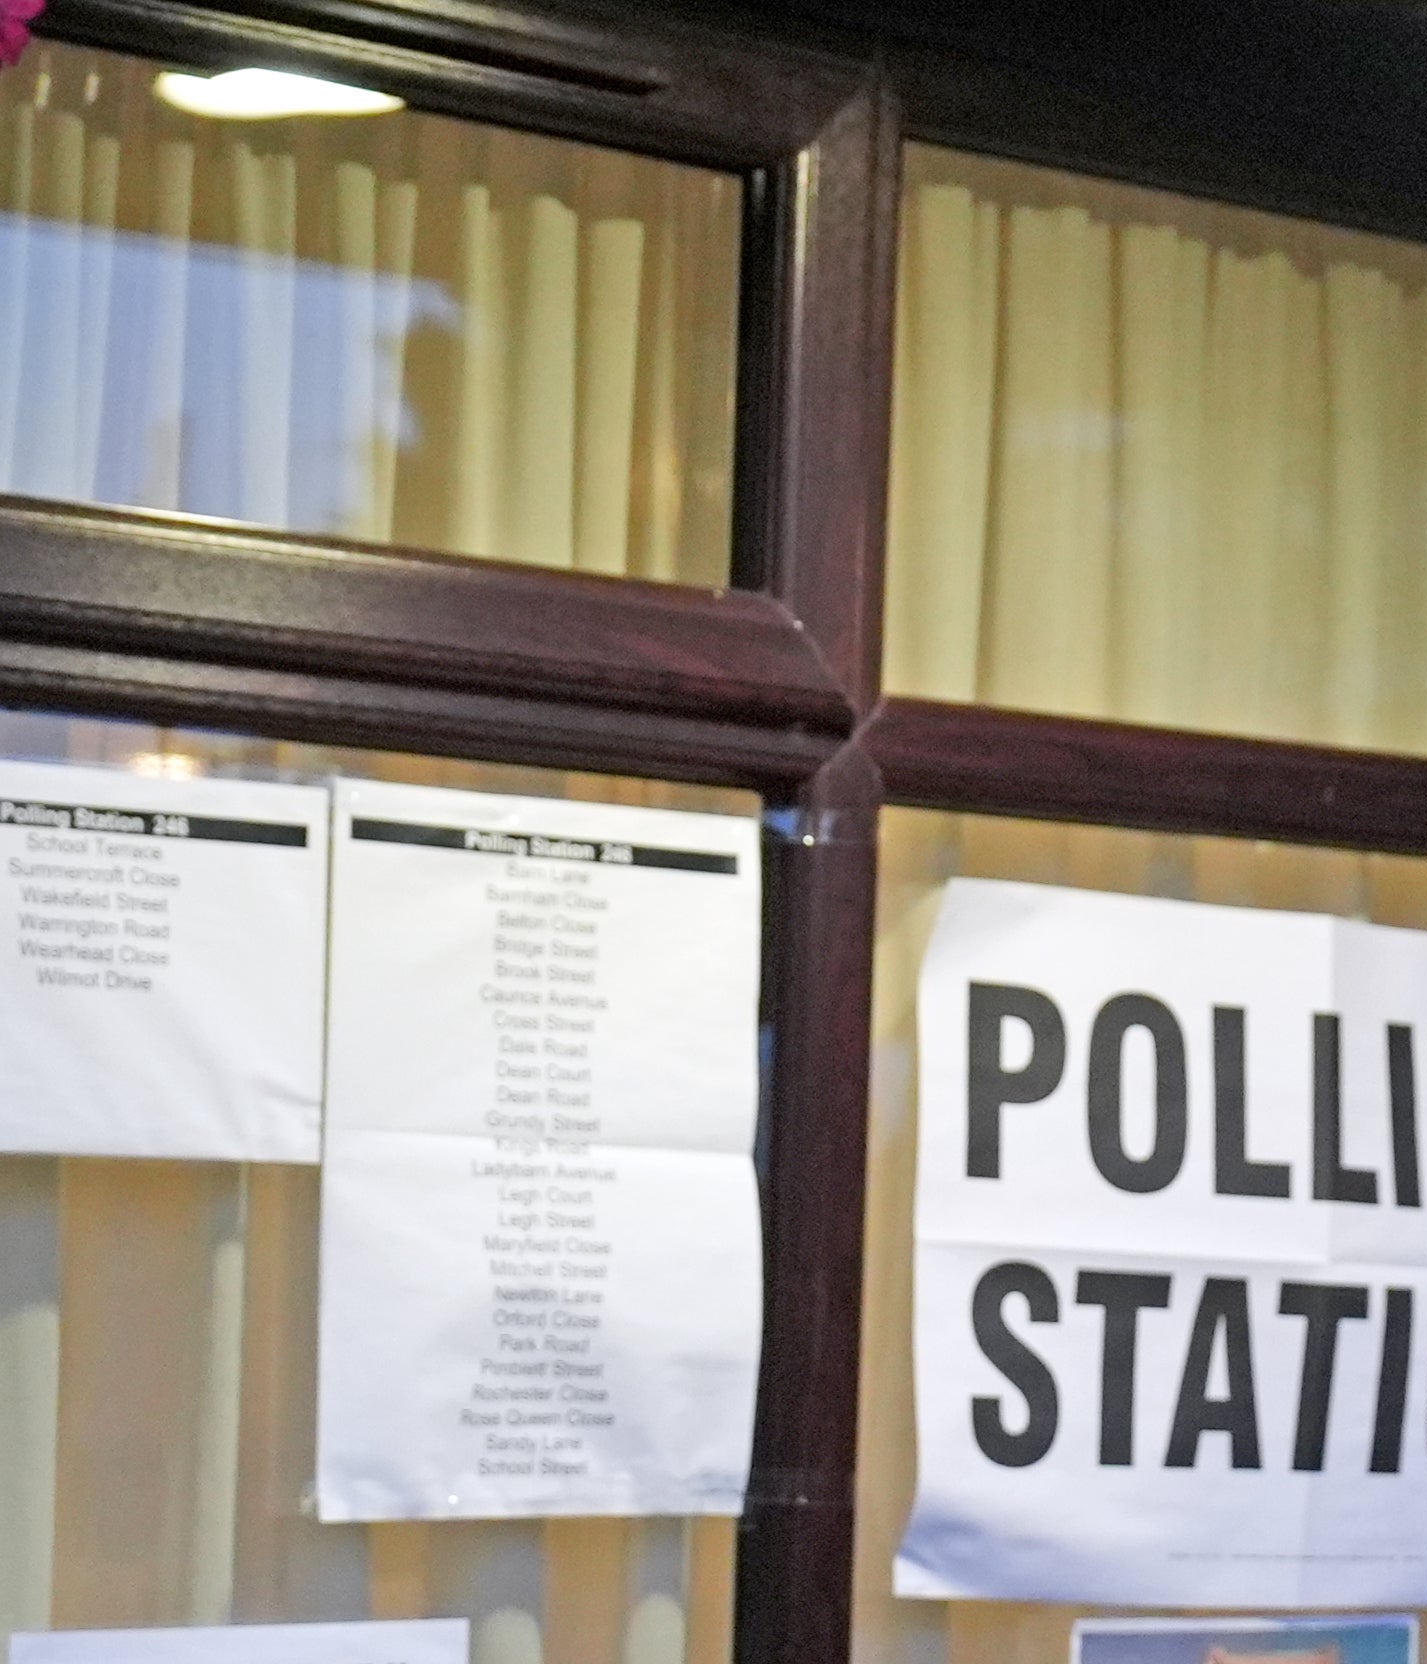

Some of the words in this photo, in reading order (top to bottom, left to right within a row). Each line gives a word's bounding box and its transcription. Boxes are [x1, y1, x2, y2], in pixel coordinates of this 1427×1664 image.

[0, 802, 70, 828] Polling
[75, 807, 144, 833] Station
[27, 832, 88, 853] School
[97, 839, 161, 860] Terrace
[466, 830, 527, 855] Polling
[531, 837, 594, 860] Station
[10, 858, 123, 881] Summercroft
[130, 868, 179, 886] Close
[21, 887, 109, 909] Wakefield
[118, 893, 167, 912] Street
[564, 891, 607, 911] Close
[19, 913, 116, 937] Warrington
[125, 919, 169, 938] Road
[551, 915, 596, 935] Close
[19, 940, 112, 962] Wearhead
[120, 946, 169, 965] Close
[495, 936, 544, 957] Bridge
[552, 941, 597, 959] Street
[37, 967, 98, 986] Wilmot
[105, 972, 151, 989] Drive
[496, 961, 540, 979] Brook
[549, 965, 594, 983] Street
[549, 990, 607, 1009] Avenue
[494, 1010, 539, 1029] Cross
[546, 1014, 594, 1033] Street
[501, 1036, 536, 1054] Dale
[544, 1039, 587, 1057] Road
[496, 1060, 540, 1078] Dean
[546, 1063, 591, 1081] Court
[496, 1086, 540, 1105] Dean
[547, 1088, 590, 1106] Road
[485, 1110, 544, 1132] Grundy
[553, 1114, 599, 1132] Street
[556, 1163, 615, 1181] Avenue
[547, 1188, 592, 1204] Court
[546, 1212, 594, 1229] Street
[565, 1238, 610, 1255] Close
[491, 1259, 552, 1276] Mitchell
[561, 1261, 606, 1278] Street
[563, 1289, 603, 1303] Lane
[552, 1311, 599, 1328] Close
[500, 1335, 537, 1351] Park
[544, 1335, 590, 1352] Road
[553, 1361, 603, 1377] Street
[473, 1384, 552, 1400] Rochester
[559, 1385, 608, 1401] Close
[461, 1409, 500, 1425] Rose
[506, 1409, 560, 1426] Queen
[566, 1410, 614, 1426] Close
[487, 1434, 536, 1453] Sandy
[543, 1436, 581, 1451] Lane
[479, 1459, 532, 1476] School
[540, 1459, 587, 1476] Street
